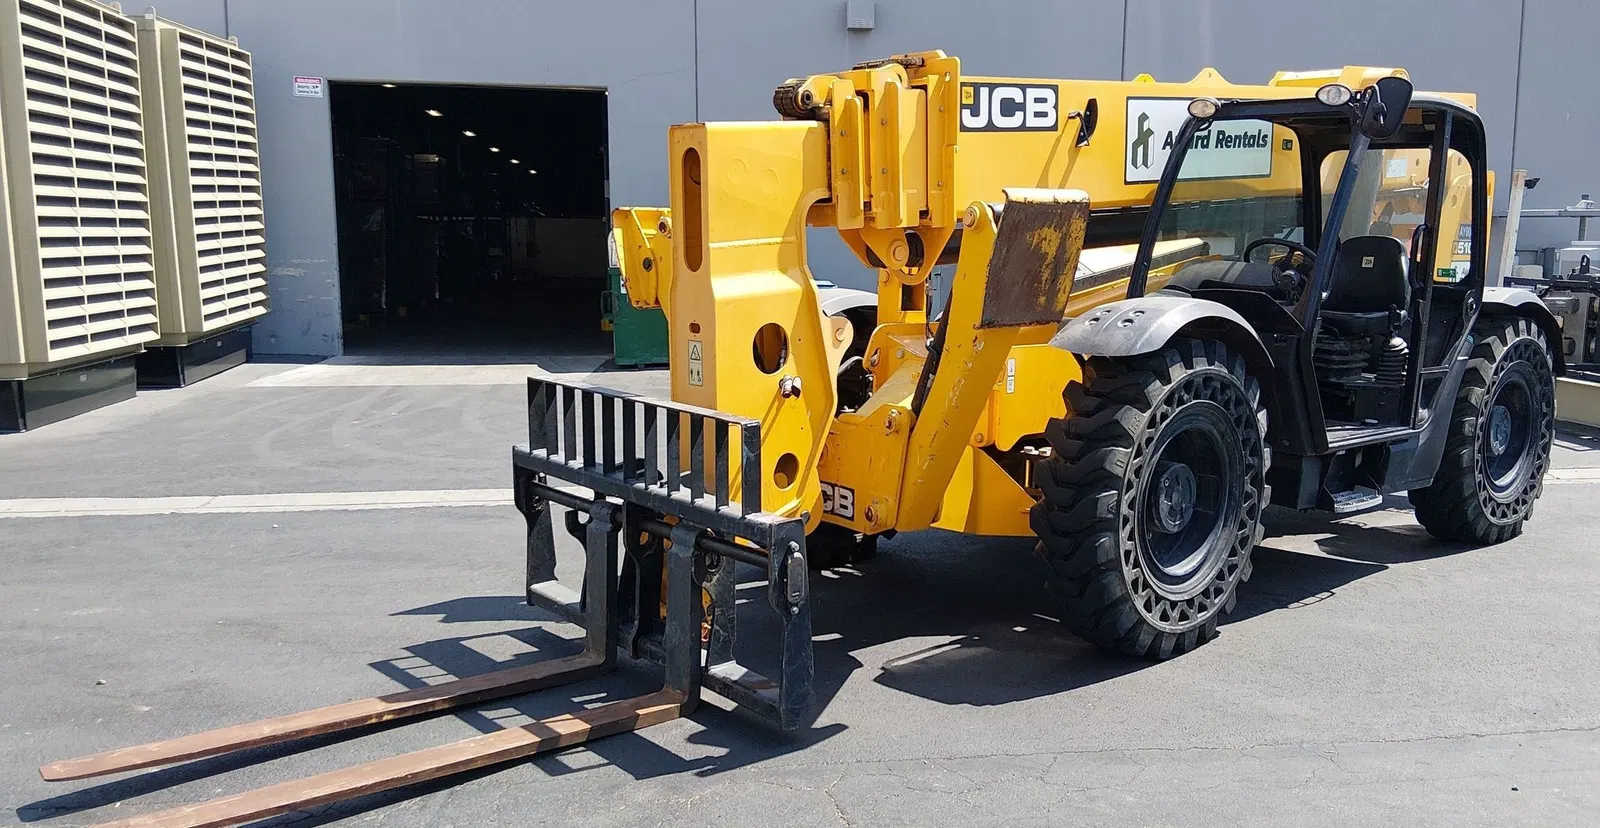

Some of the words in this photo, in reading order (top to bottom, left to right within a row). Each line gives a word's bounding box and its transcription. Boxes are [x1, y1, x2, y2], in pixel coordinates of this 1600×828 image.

[961, 86, 1057, 128] JCB
[1162, 129, 1211, 150] Ard
[1214, 129, 1269, 149] Rentals
[820, 483, 854, 518] CB
